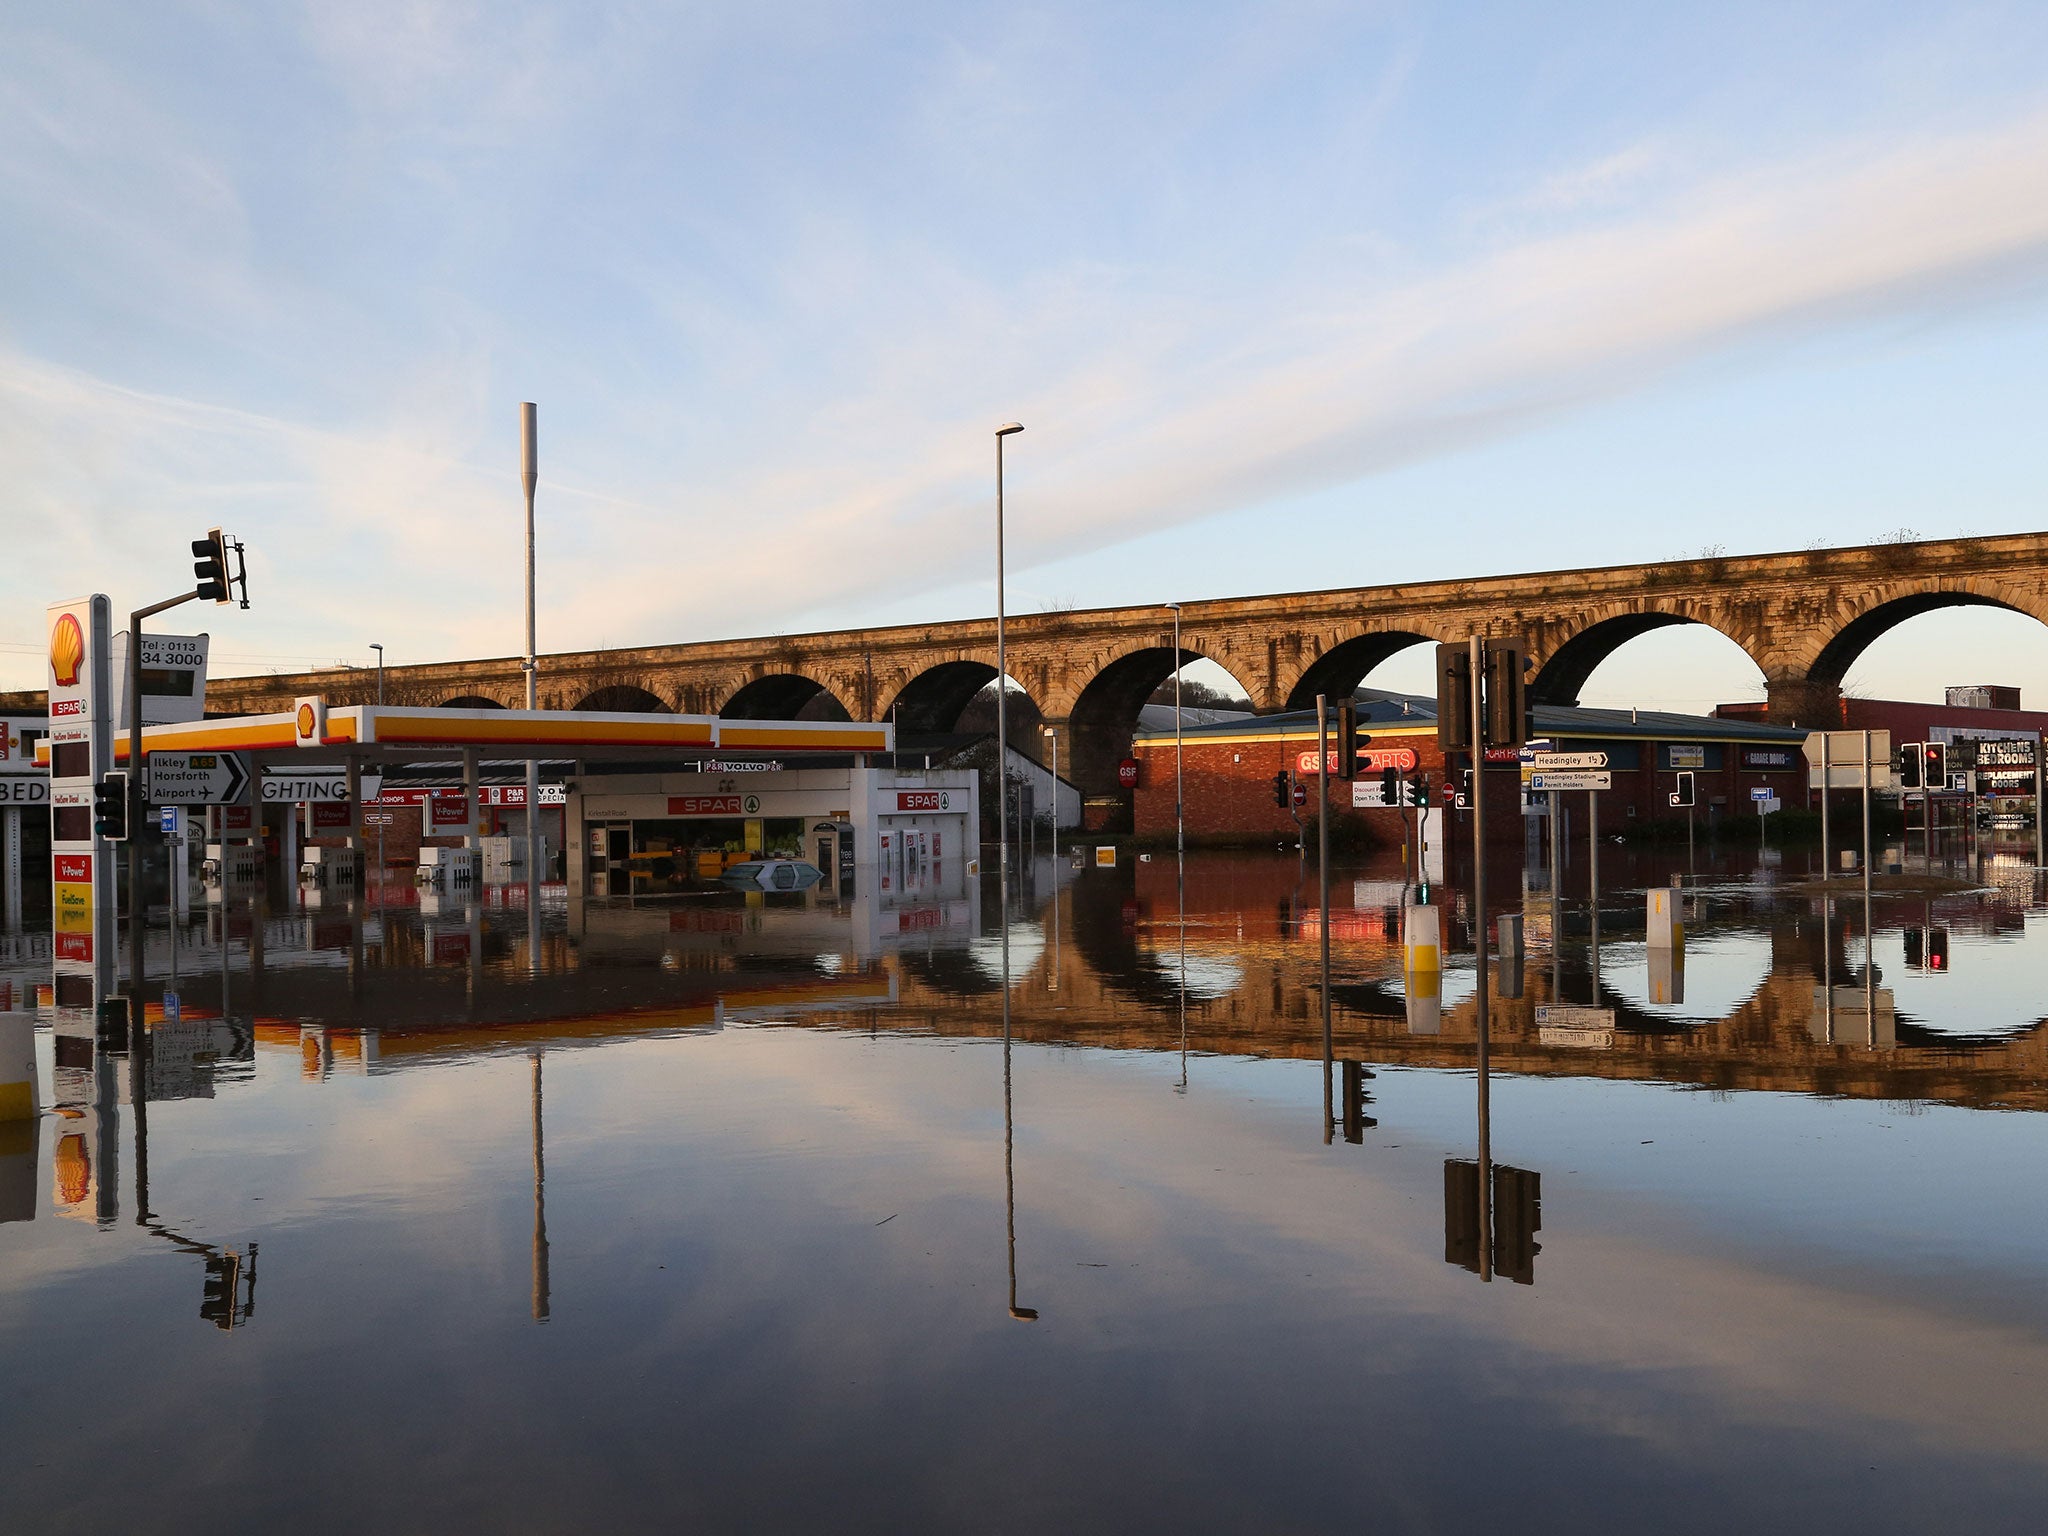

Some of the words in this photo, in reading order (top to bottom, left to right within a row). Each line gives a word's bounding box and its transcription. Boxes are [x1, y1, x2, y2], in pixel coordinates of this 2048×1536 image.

[141, 640, 159, 650] Tel
[168, 642, 196, 651] 0113
[165, 653, 203, 665] 3000
[57, 702, 80, 714] SPAR
[1980, 741, 2031, 753] KITCHENS
[154, 758, 185, 768] Ilkley
[1538, 757, 1582, 765] Headingley
[1976, 753, 2034, 765] BEDROOMS
[725, 763, 765, 771] VOLVO
[1119, 766, 1137, 777] GSF
[154, 771, 210, 781] Horsforth
[1977, 770, 2035, 780] REPLACEMENT
[1991, 780, 2020, 788] DOORS
[154, 788, 196, 799] Airport
[507, 788, 524, 796] P&R
[685, 798, 741, 812] SPAR
[906, 795, 939, 808] SPAR
[436, 807, 464, 816] V-Power
[61, 864, 85, 877] V-Power
[62, 894, 85, 905] FuelSave
